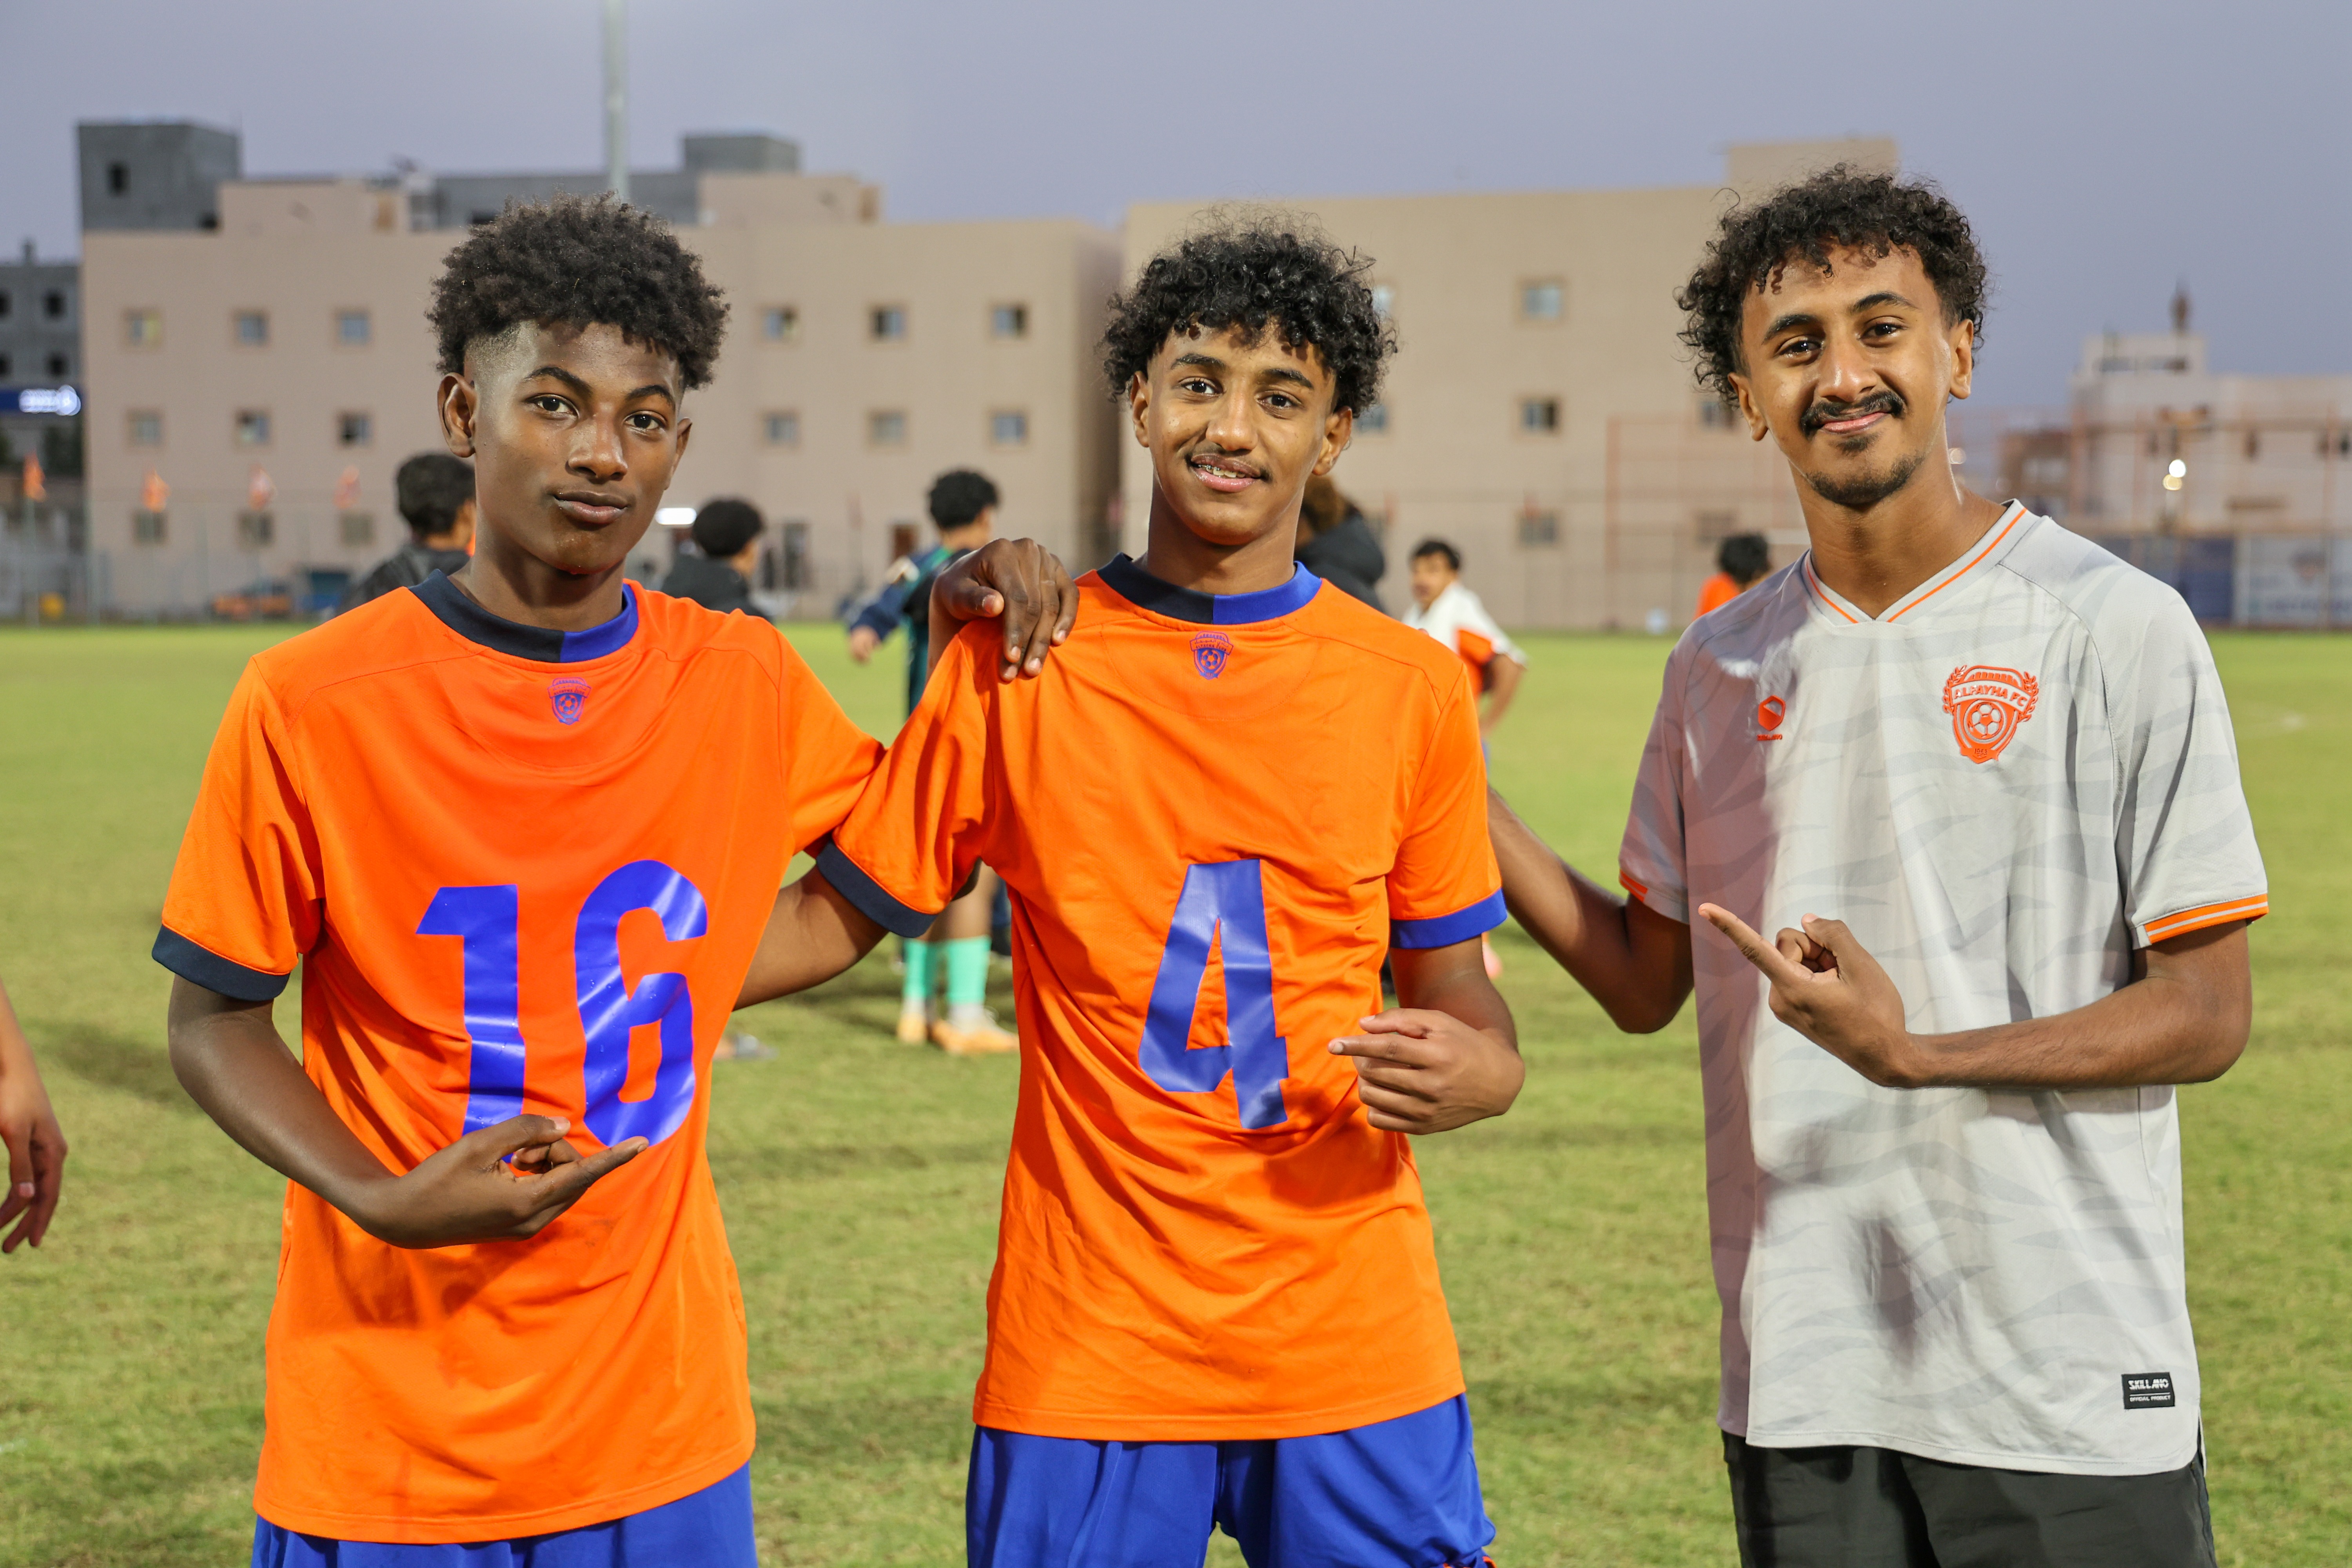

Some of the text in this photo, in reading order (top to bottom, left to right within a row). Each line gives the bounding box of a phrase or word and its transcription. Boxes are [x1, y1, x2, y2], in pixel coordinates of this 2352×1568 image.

[1954, 685, 2027, 706] ALFAYHA FC
[416, 859, 708, 1163] 16
[1138, 858, 1289, 1129] 4
